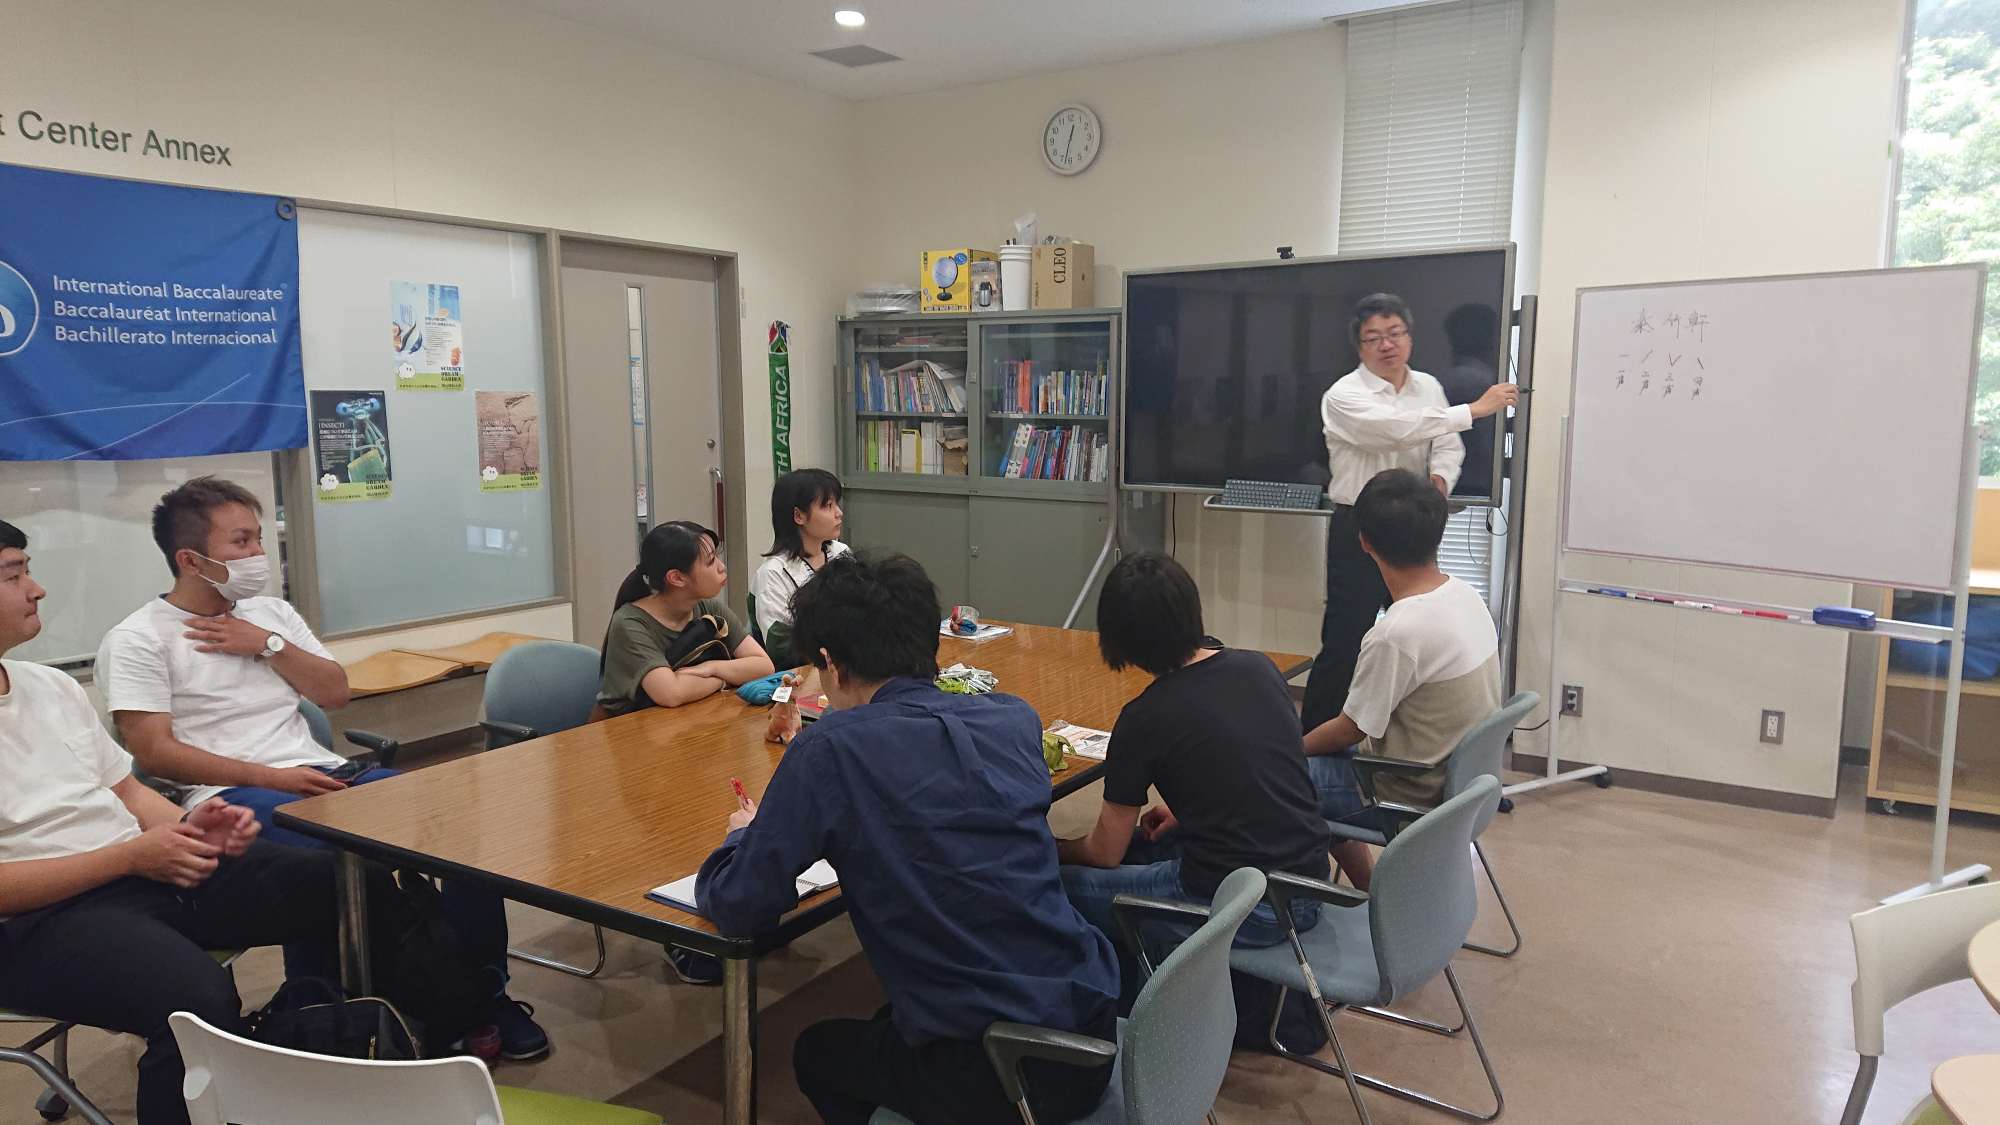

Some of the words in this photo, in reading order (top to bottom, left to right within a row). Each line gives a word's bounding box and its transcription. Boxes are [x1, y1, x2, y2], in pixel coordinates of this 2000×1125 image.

[1068, 114, 1074, 122] 12
[17, 110, 132, 153] Center
[142, 129, 232, 166] Annex
[1052, 127, 1058, 135] 10
[1087, 133, 1091, 141] 3
[1053, 247, 1067, 284] CLEO
[53, 275, 168, 298] International
[173, 284, 283, 300] Baccalaureate
[54, 301, 171, 321] Baccalauréat
[175, 307, 276, 322] International
[55, 326, 166, 345] Bachillerato
[171, 329, 277, 345] Internacional
[775, 365, 788, 446] AFRICA
